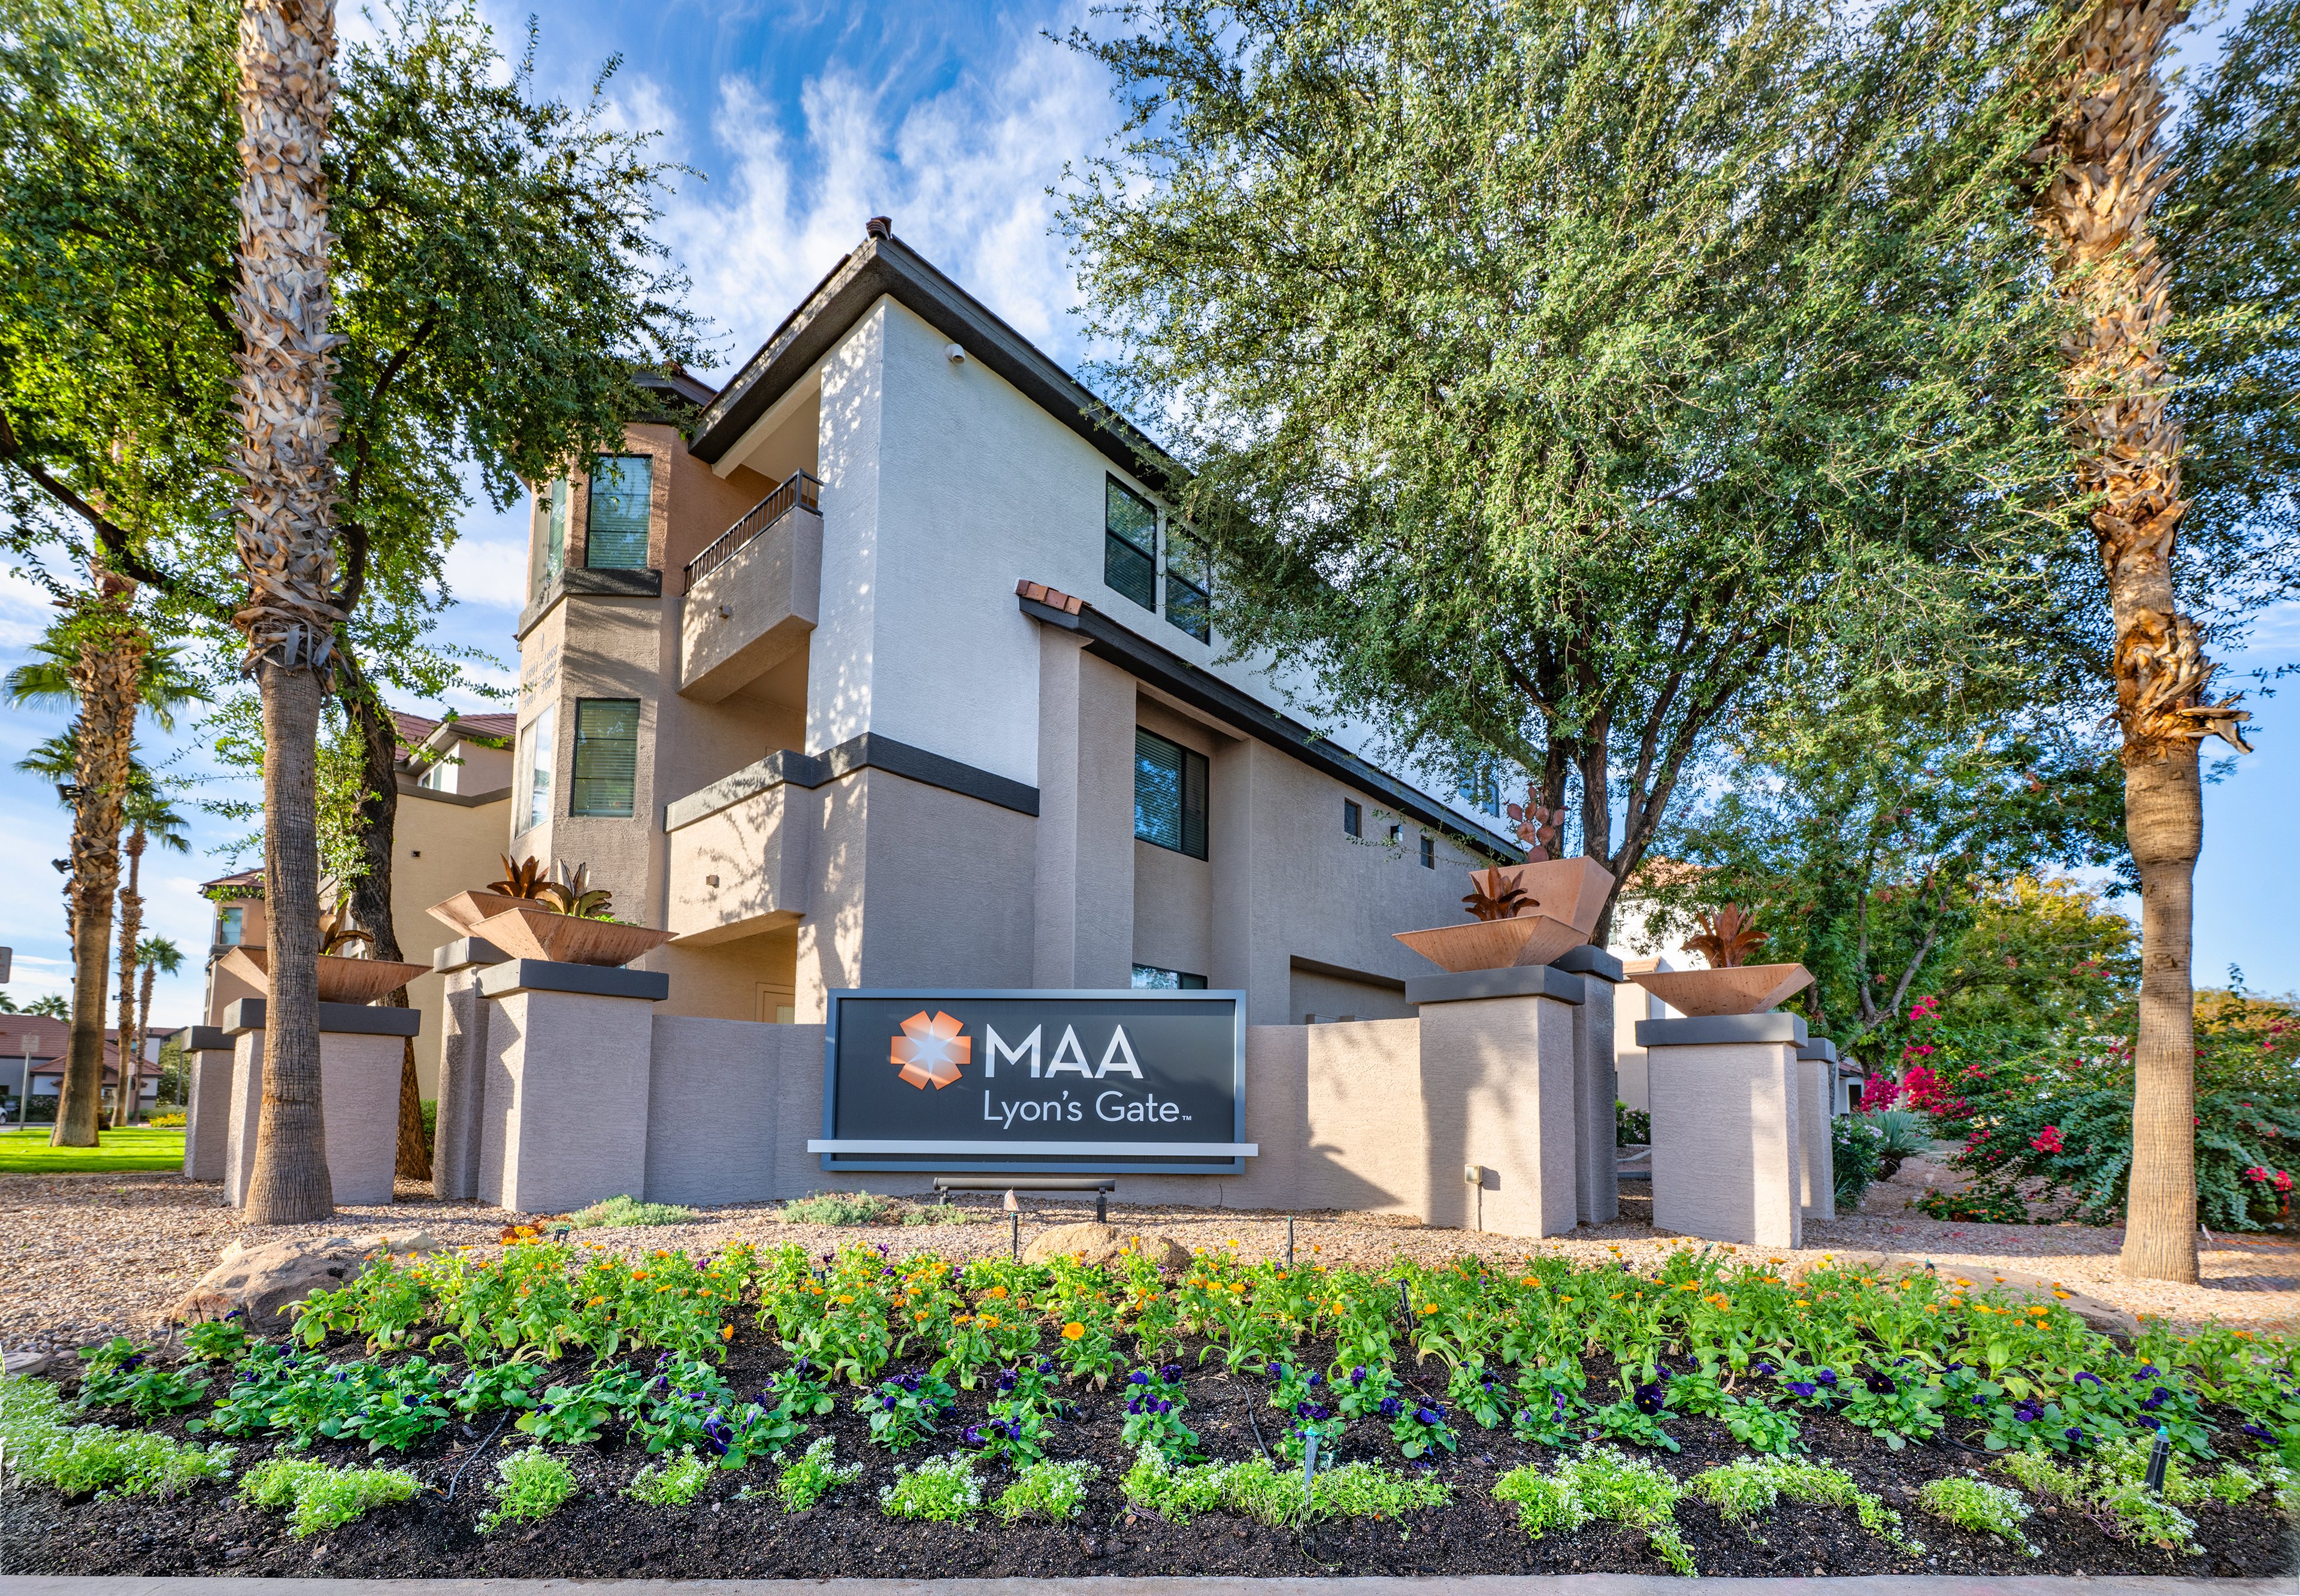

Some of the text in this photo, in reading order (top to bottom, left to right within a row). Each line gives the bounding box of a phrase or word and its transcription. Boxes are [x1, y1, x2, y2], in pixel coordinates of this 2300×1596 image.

[985, 1023, 1144, 1079] MAA
[984, 1090, 1082, 1129] Lyon's
[1095, 1091, 1179, 1122] Gate
